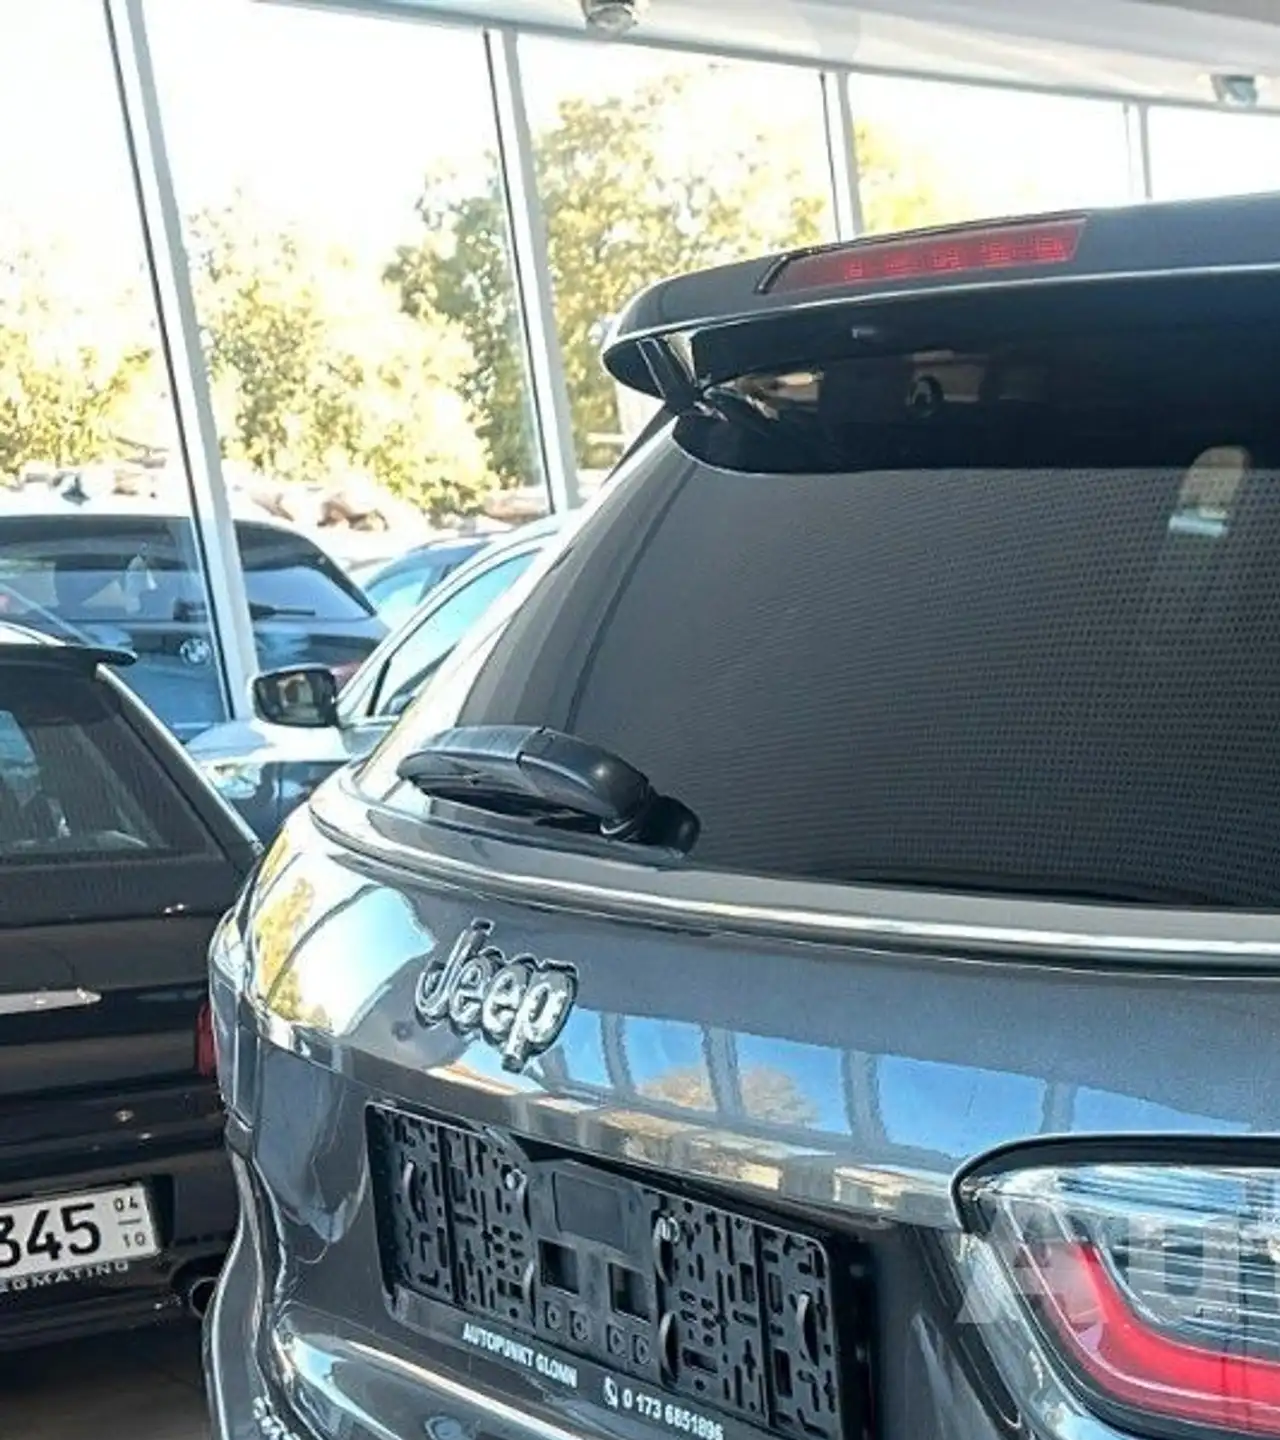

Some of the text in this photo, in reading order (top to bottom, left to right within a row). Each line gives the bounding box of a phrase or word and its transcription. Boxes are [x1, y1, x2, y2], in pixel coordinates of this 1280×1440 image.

[415, 918, 578, 1073] Jeep
[113, 1196, 140, 1212] 04
[0, 1203, 100, 1268] 345
[122, 1231, 146, 1249] 10
[462, 1322, 578, 1389] AUTOPUNKT GLONN
[635, 1392, 662, 1420] 173
